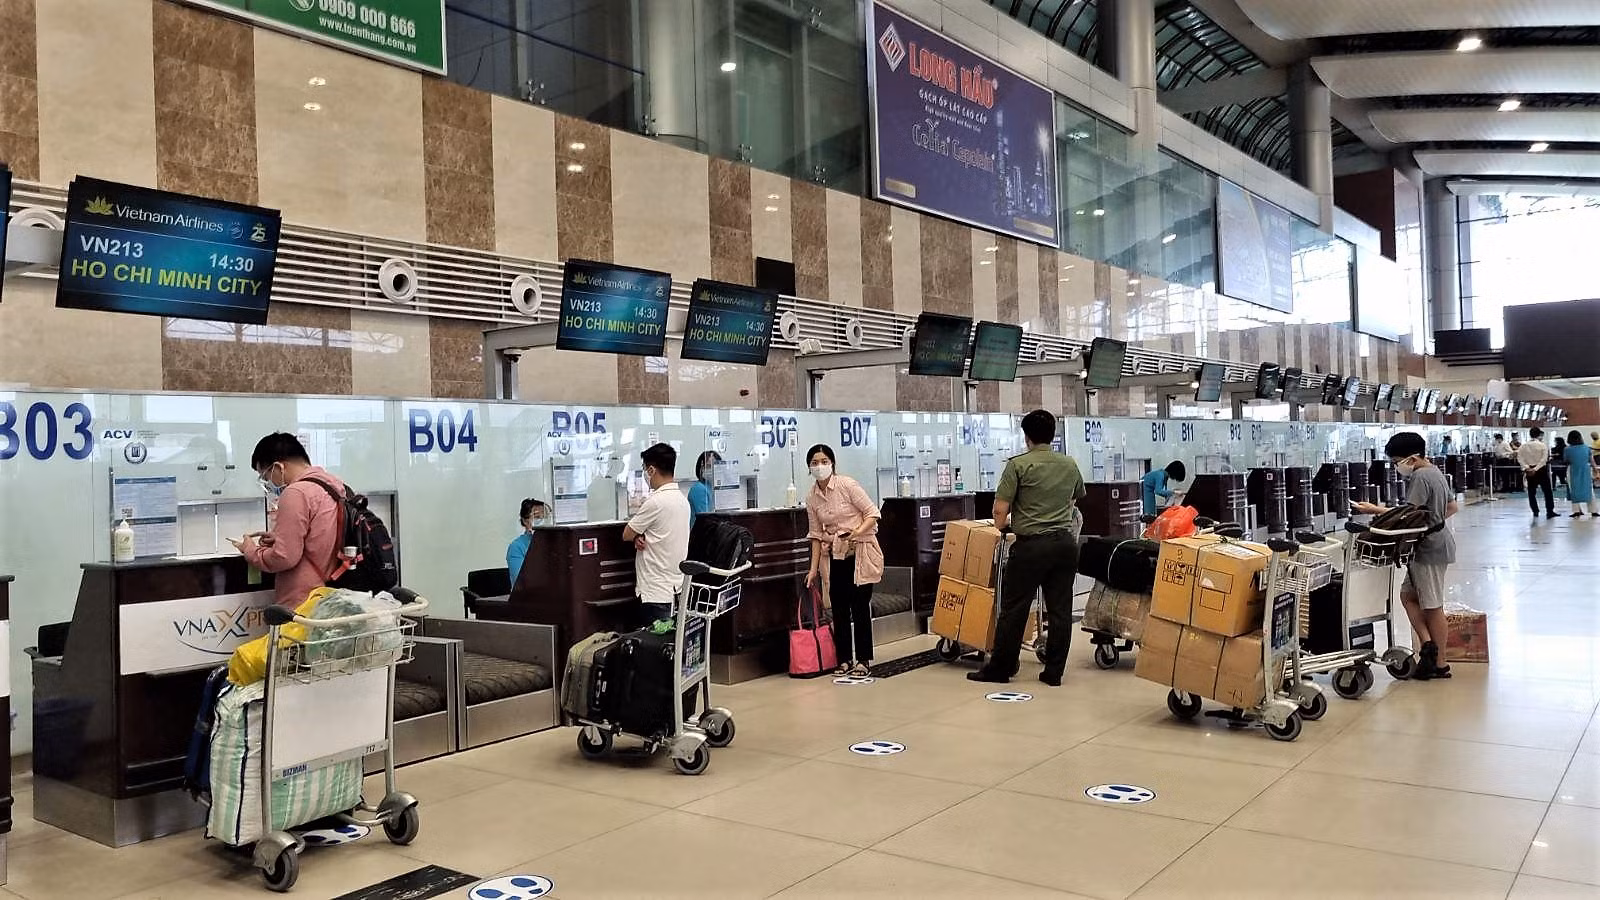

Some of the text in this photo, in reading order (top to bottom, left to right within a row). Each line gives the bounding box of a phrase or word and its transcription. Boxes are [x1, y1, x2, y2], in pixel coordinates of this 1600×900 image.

[360, 5, 387, 30] 000
[390, 13, 416, 38] 666
[319, 16, 417, 54] www.toanthang.com.vn
[909, 42, 957, 95] LONG
[80, 234, 254, 273] VN213 14:30
[72, 258, 262, 296] HO CHI MINH CITY
[570, 298, 657, 319] VN213 14:30
[564, 315, 662, 336] HO CHI MINH CITY
[695, 313, 765, 332] VN213 14:30
[689, 328, 767, 347] HO CHI MINH CITY
[103, 430, 133, 439] ACV
[408, 408, 478, 453] B04
[760, 415, 798, 448] B0
[840, 416, 872, 447] B07
[1151, 422, 1166, 441] B10
[1181, 422, 1194, 441] B11
[1229, 423, 1241, 441] B12
